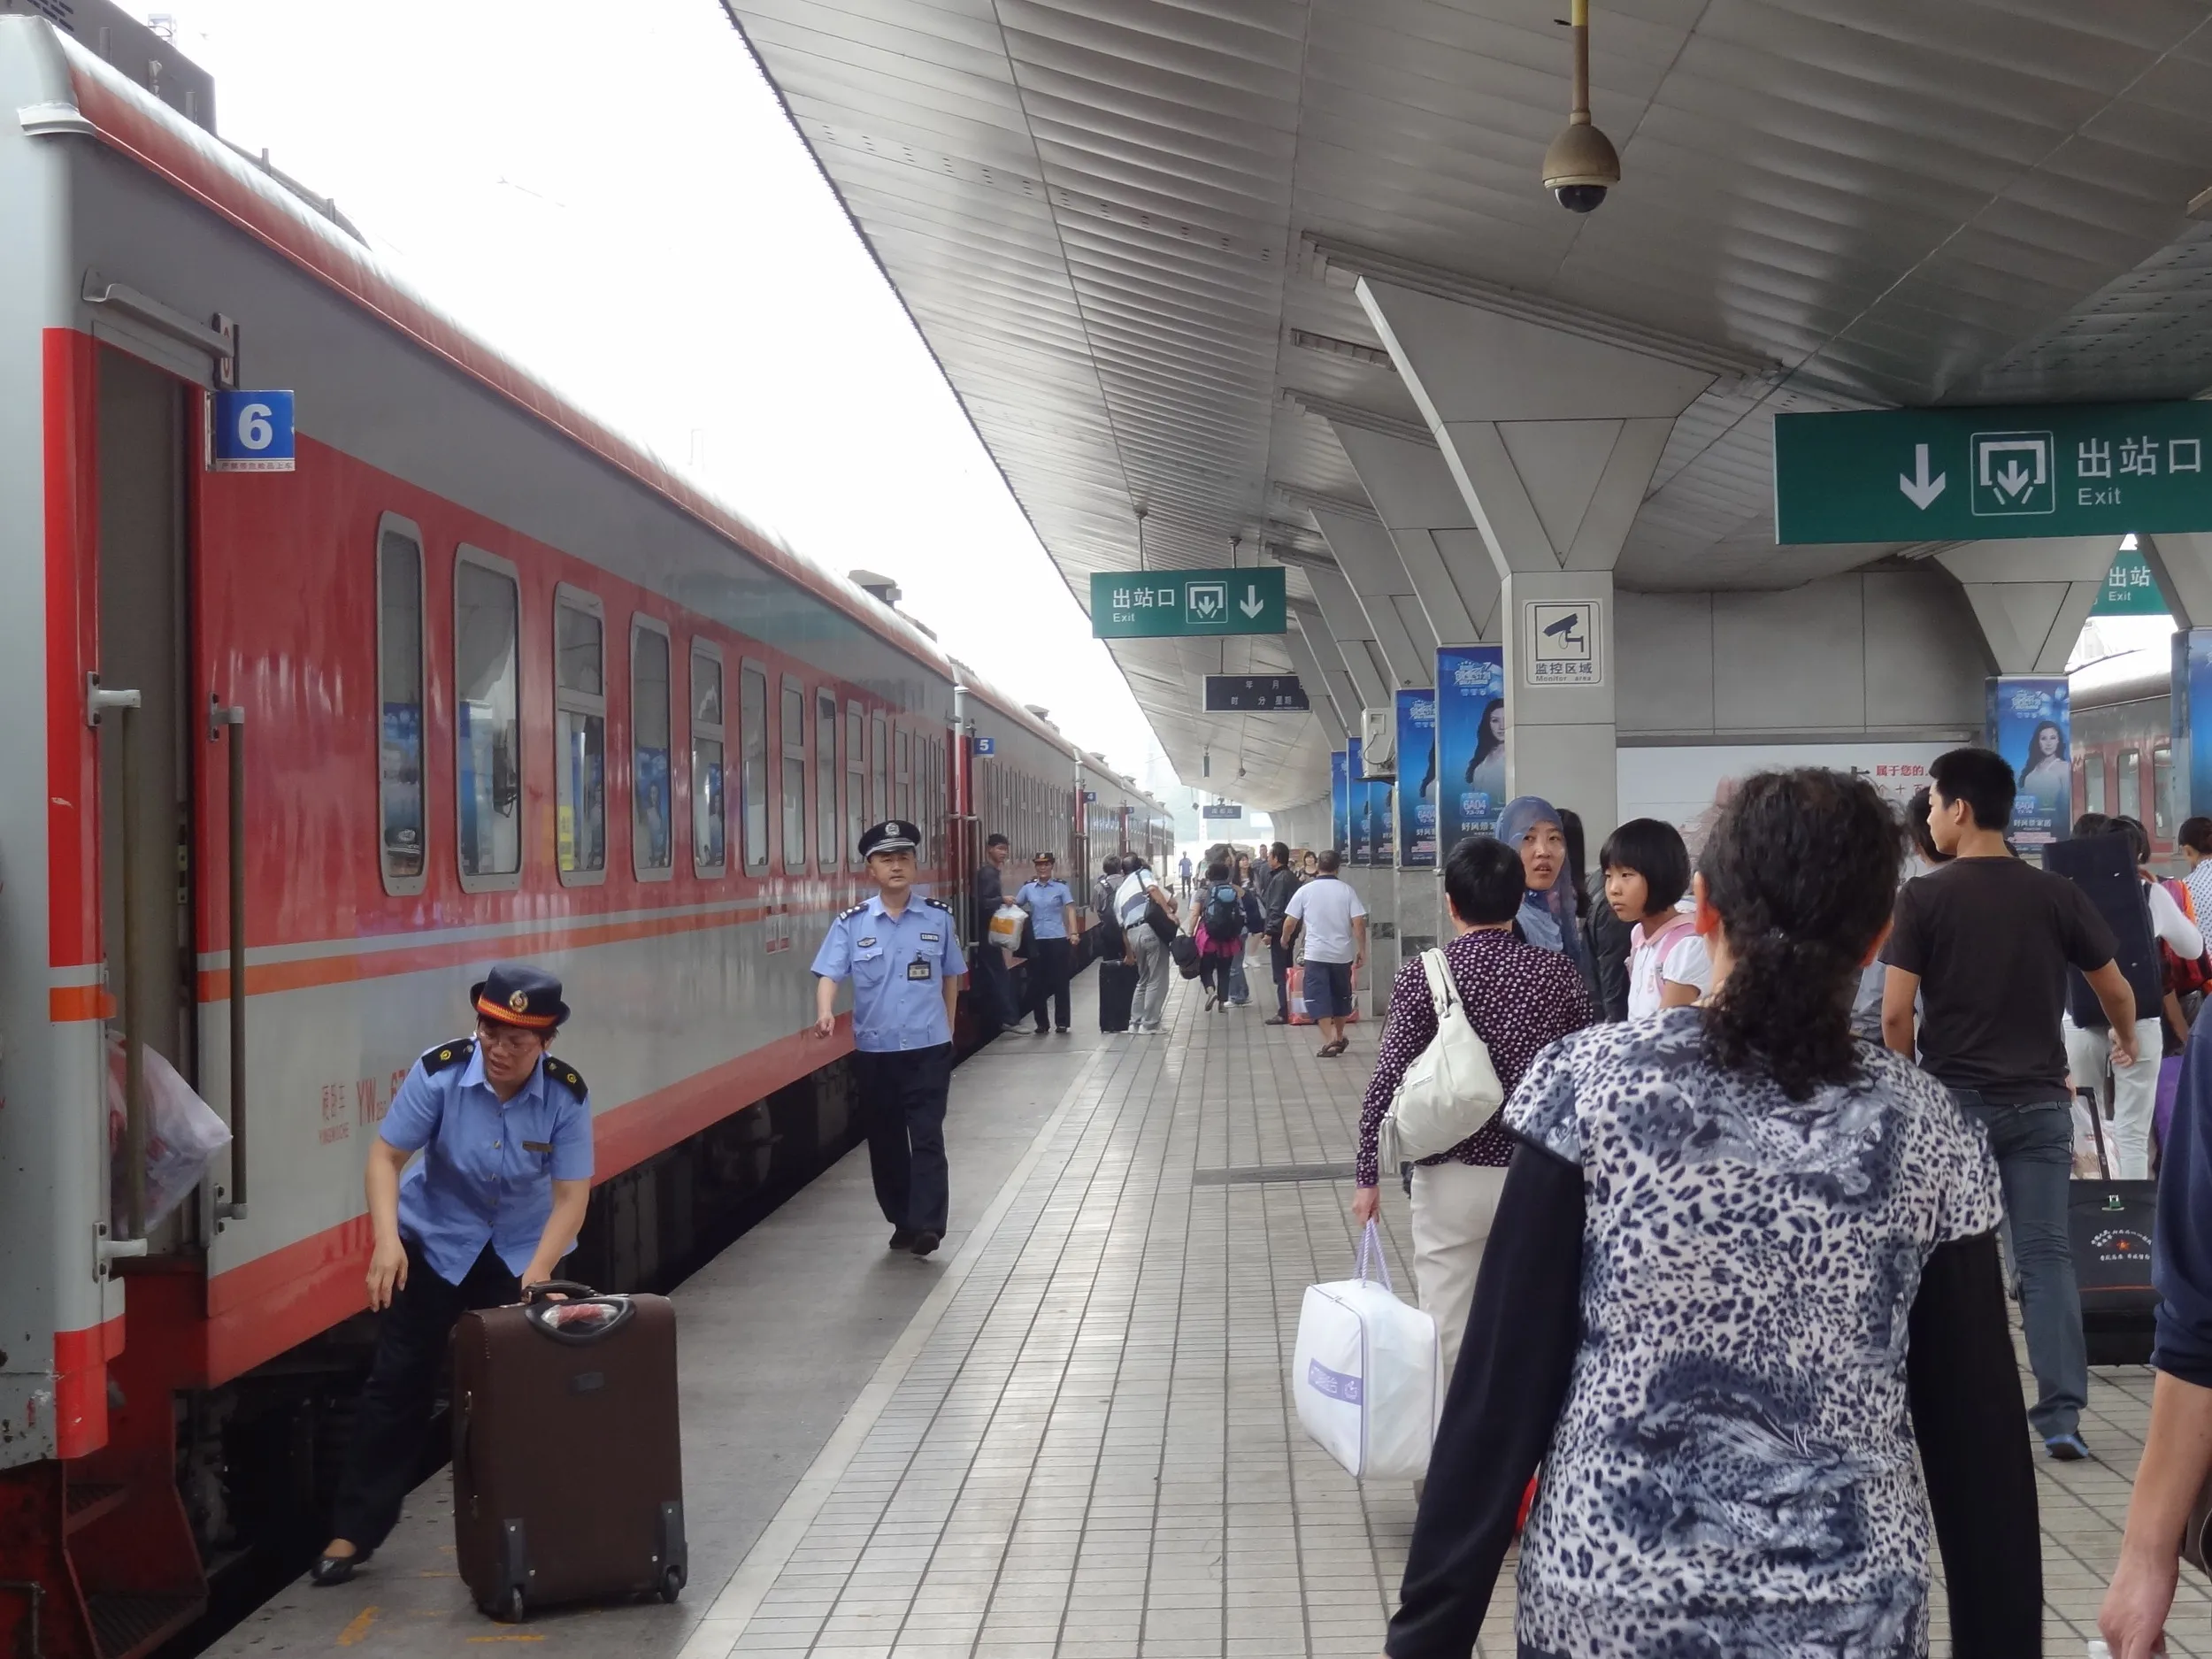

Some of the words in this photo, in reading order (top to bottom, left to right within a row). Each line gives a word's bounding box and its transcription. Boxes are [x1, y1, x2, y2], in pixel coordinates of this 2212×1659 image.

[238, 403, 273, 449] 6
[2078, 436, 2201, 478] 出站口
[2078, 488, 2121, 505] Exit
[2109, 565, 2151, 587] 出站
[1113, 587, 1175, 609] 出站口
[2108, 591, 2131, 602] Exit
[1113, 612, 1135, 622] Exit
[1535, 663, 1593, 674] 监控区域
[1245, 680, 1254, 689] 年
[1272, 680, 1279, 689] 月
[1257, 696, 1266, 705] 分
[979, 739, 989, 751] 5
[1876, 764, 1924, 777] 属于您的
